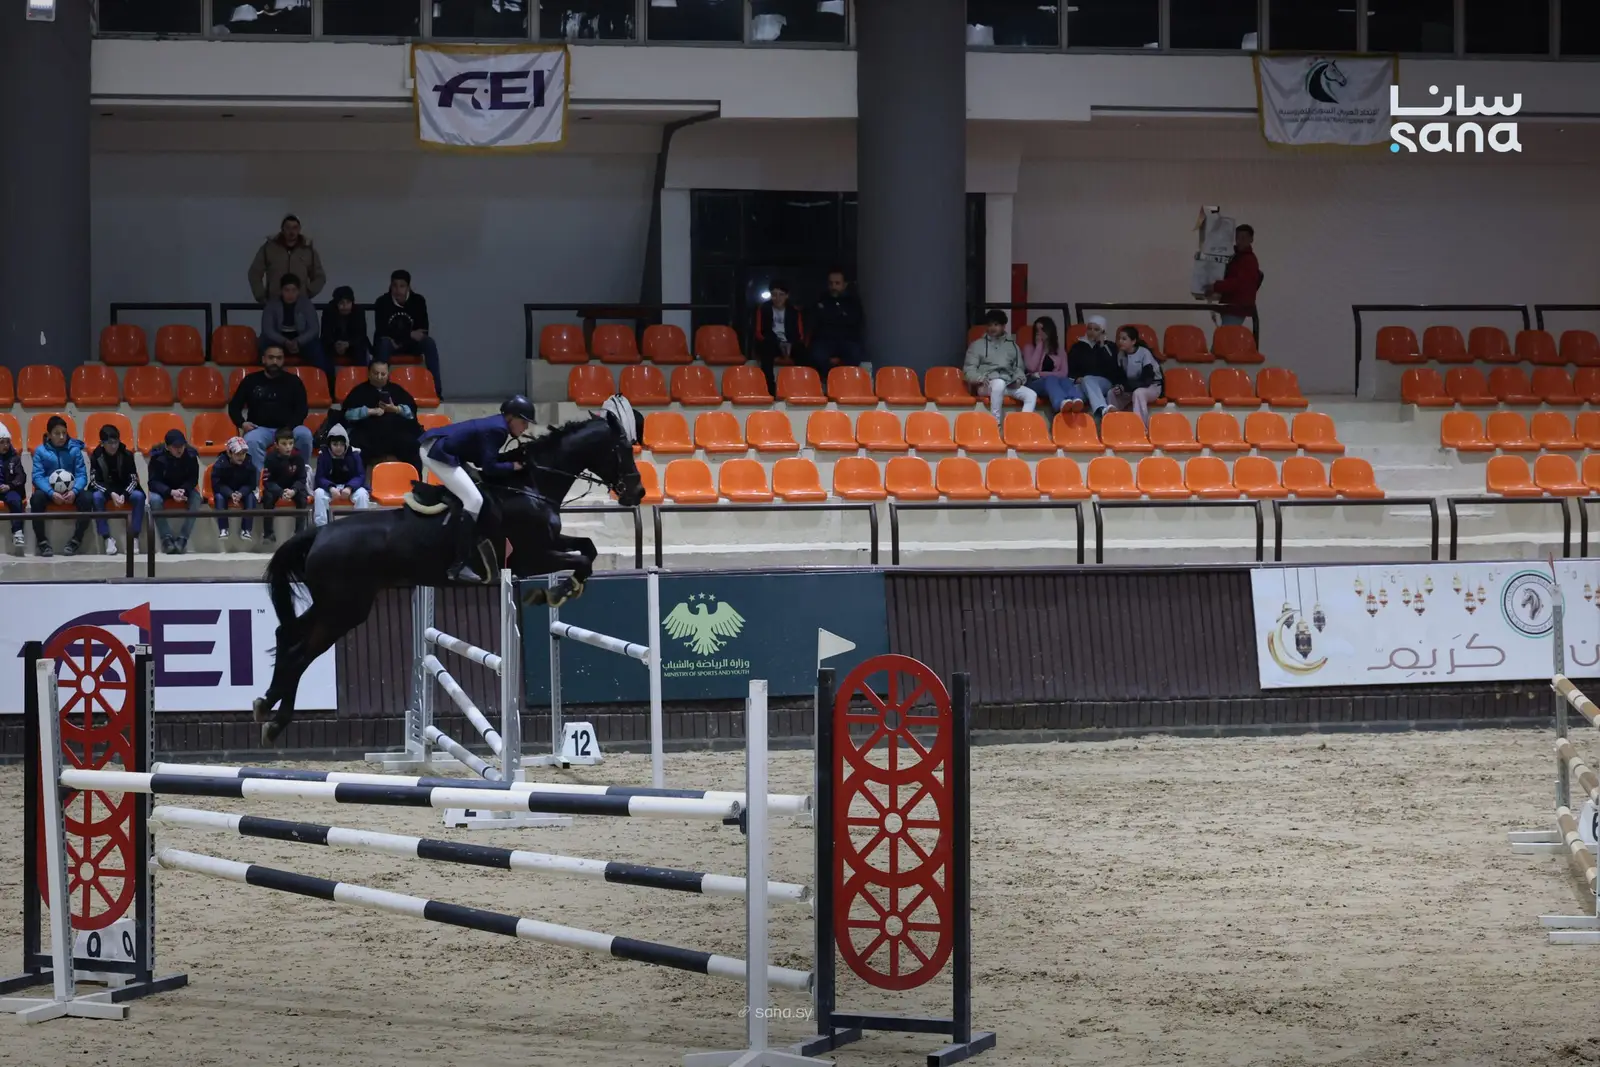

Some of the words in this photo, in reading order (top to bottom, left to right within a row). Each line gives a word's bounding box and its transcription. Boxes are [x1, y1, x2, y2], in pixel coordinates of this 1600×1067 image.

[432, 70, 545, 110] FEI
[662, 660, 695, 671] والشباب
[696, 658, 728, 670] الرياضة
[730, 658, 750, 668] وزارة
[571, 729, 591, 756] 12
